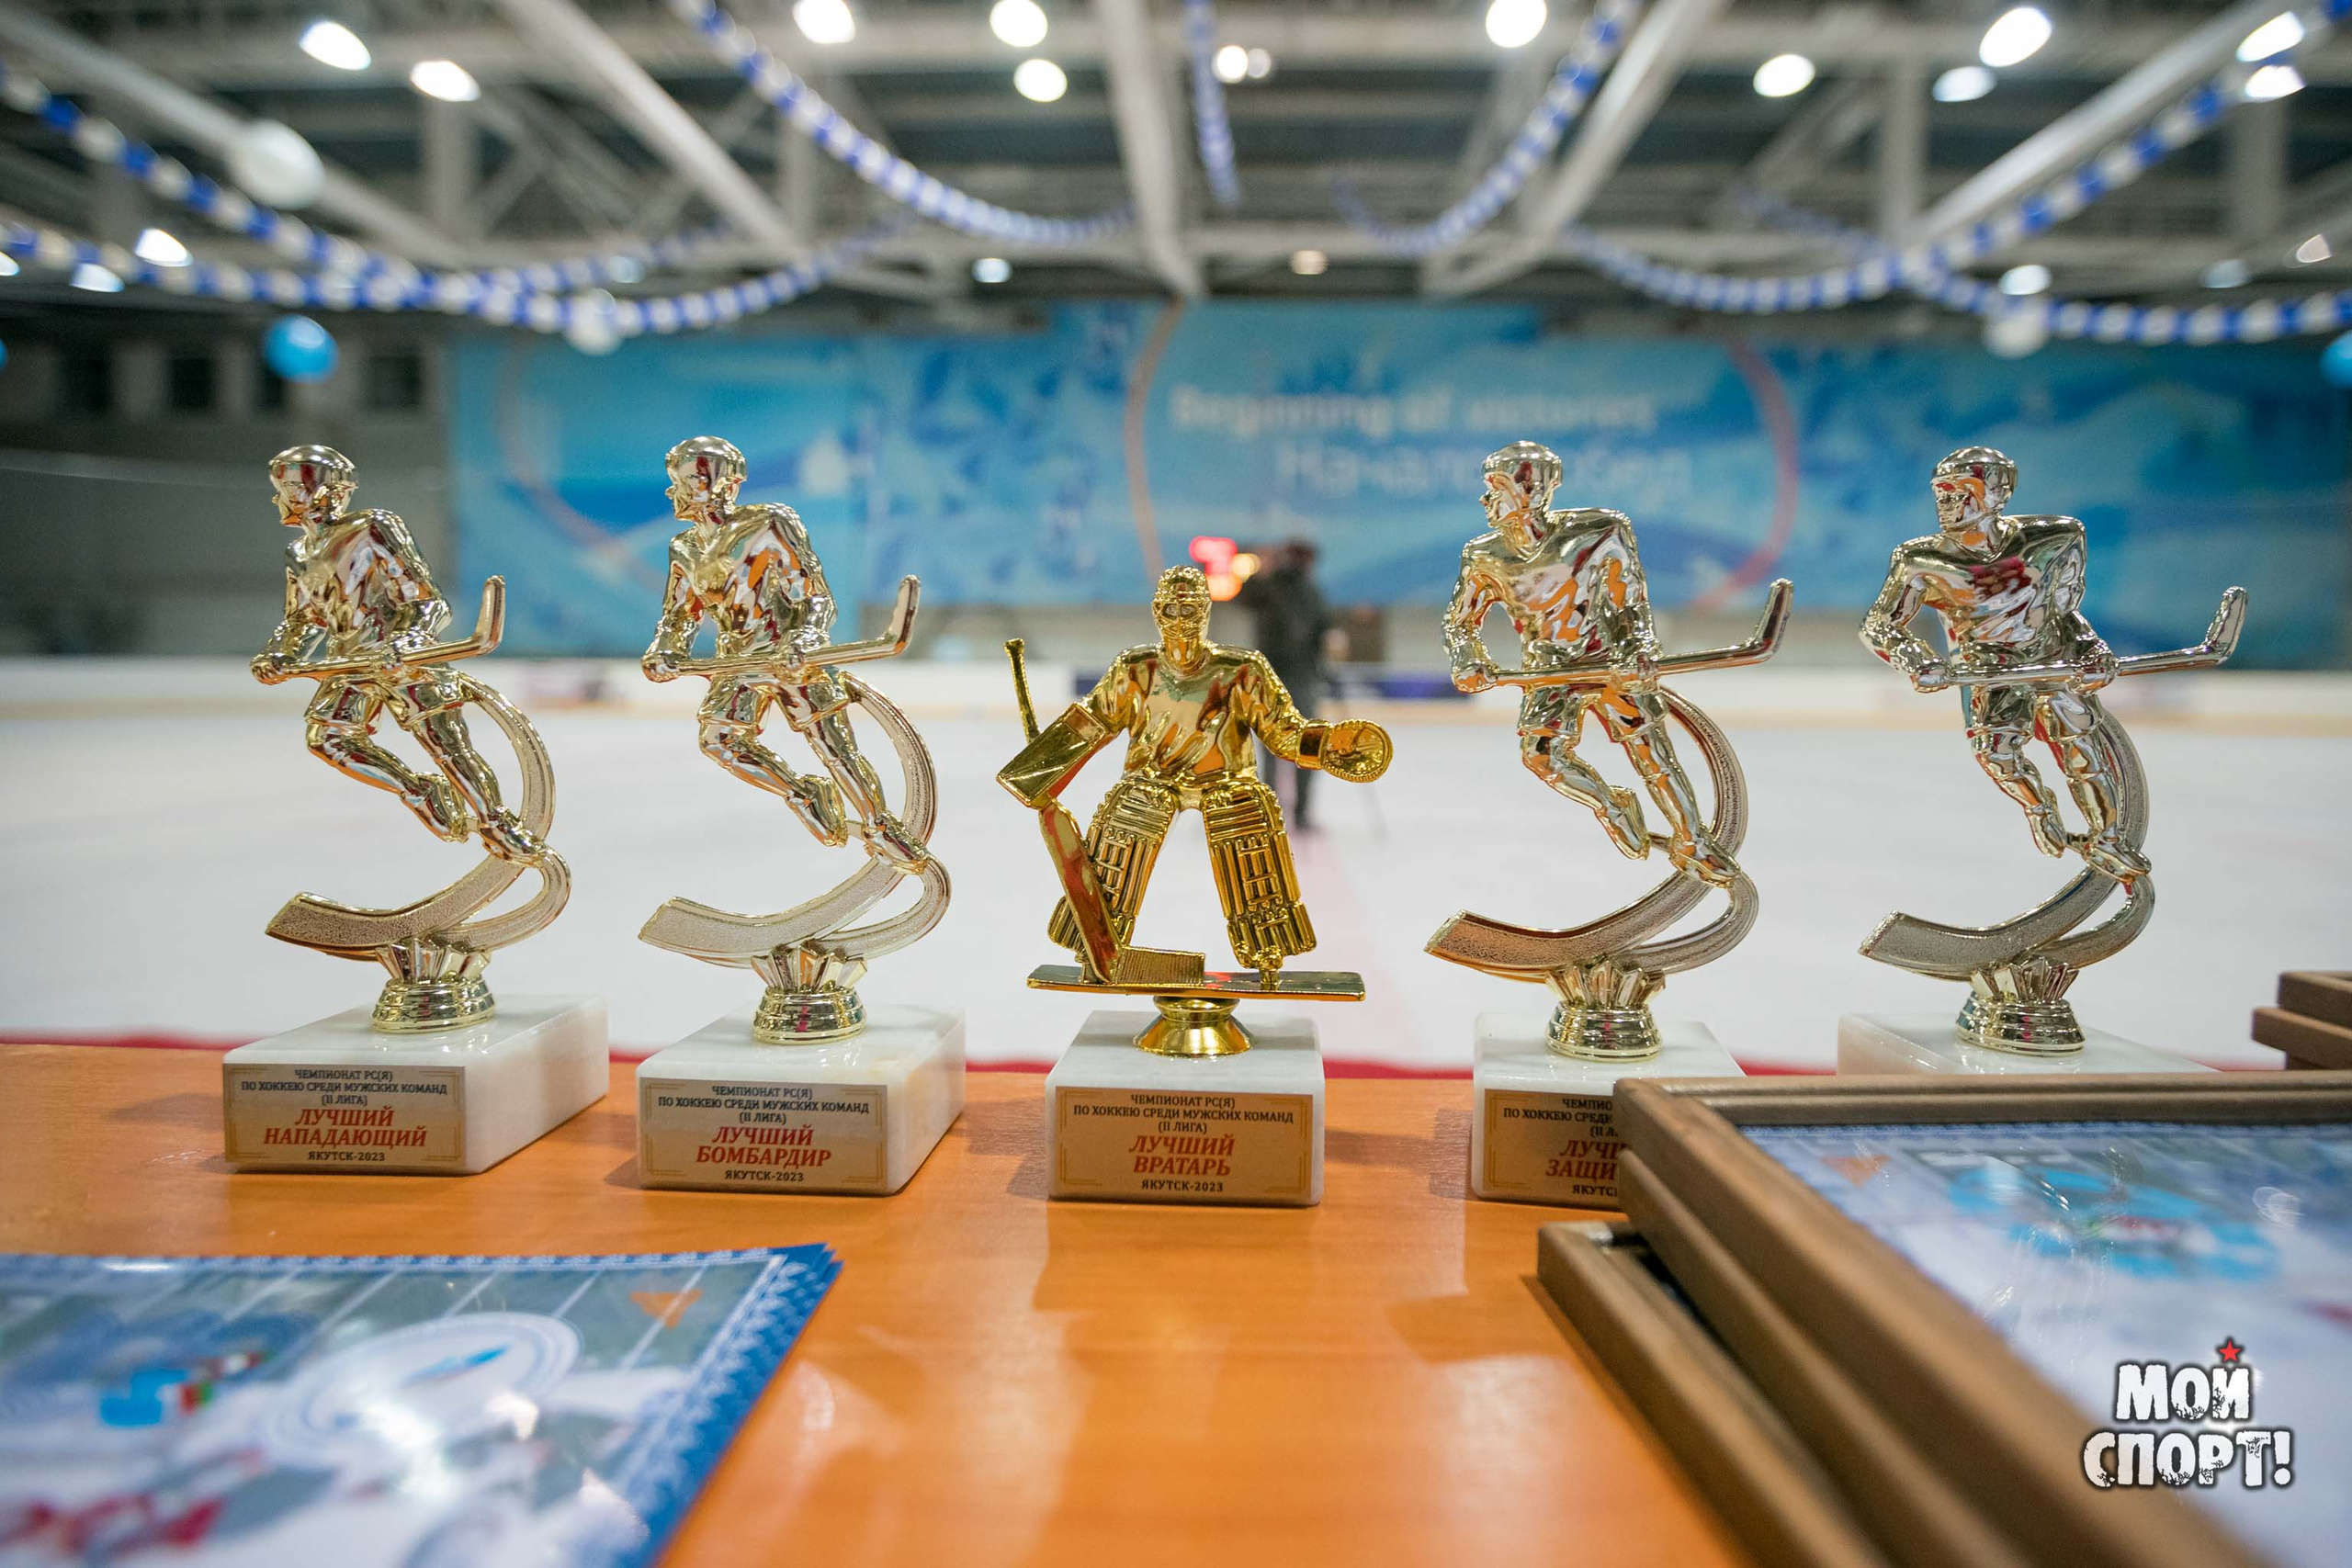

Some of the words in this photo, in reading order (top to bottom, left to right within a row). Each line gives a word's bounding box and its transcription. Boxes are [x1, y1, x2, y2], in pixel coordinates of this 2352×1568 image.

[295, 1069, 361, 1080] ЧЕМПИОНАТ
[364, 1070, 393, 1082] РС(Я)
[241, 1081, 255, 1091] ПО
[258, 1081, 304, 1091] ХОККЕЮ
[306, 1082, 342, 1093] СРЕДИ
[345, 1082, 399, 1093] МУЖСКИХ
[401, 1084, 447, 1095] КОМАНД
[711, 1085, 780, 1098] ЧЕМПИОНАТ
[783, 1088, 813, 1100] РС(Я)
[335, 1095, 368, 1106] ЛИГА)
[658, 1096, 673, 1107] ПО
[675, 1097, 721, 1108] ХОККЕЮ
[724, 1099, 760, 1111] СРЕДИ
[763, 1100, 819, 1111] МУЖСКИХ
[821, 1101, 869, 1113] КОМАНД
[1130, 1094, 1203, 1107] ЧЕМПИОНАТ
[1205, 1097, 1236, 1109] РС(Я)
[1562, 1099, 1613, 1111] ЧЕМПИО
[294, 1106, 395, 1127] ЛУЧШИЙ
[752, 1113, 786, 1125] ЛИГА)
[1073, 1105, 1090, 1115] ПО
[1091, 1106, 1140, 1117] ХОККЕЮ
[1143, 1108, 1180, 1120] СРЕДИ
[1182, 1110, 1241, 1121] МУЖСКИХ
[1244, 1111, 1294, 1123] КОМАНД
[1503, 1108, 1520, 1119] ПО
[1521, 1109, 1572, 1122] ХОККЕЮ
[711, 1124, 815, 1146] ЛУЧШИЙ
[1172, 1122, 1207, 1134] ЛИГА)
[263, 1125, 428, 1149] НАПАДАЮЩИЙ
[1128, 1134, 1236, 1156] ЛУЧШИЙ
[307, 1151, 385, 1162] ЯКУТСК-2023
[696, 1145, 831, 1168] БОМБАРДИР
[1133, 1156, 1231, 1177] ВРАТАРЬ
[1545, 1159, 1617, 1182] ЗАЩИ
[724, 1169, 804, 1182] ЯКУТСК-2023
[1141, 1179, 1224, 1192] ЯКУТСК-2023
